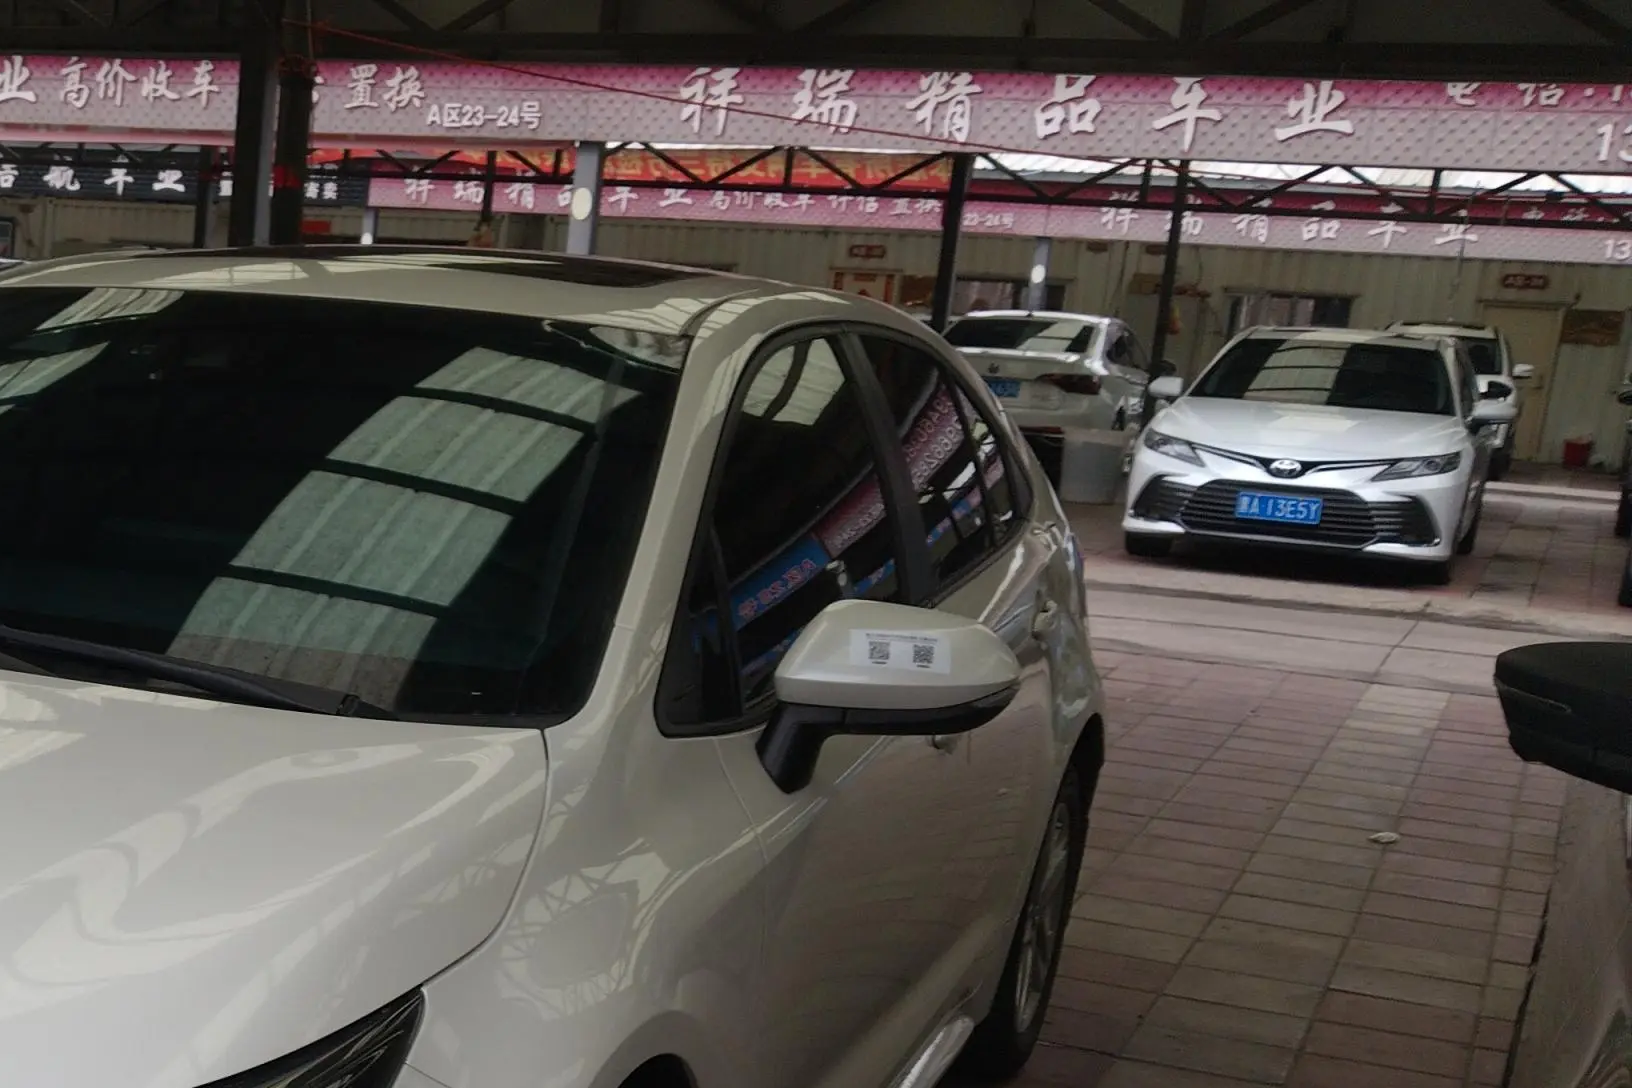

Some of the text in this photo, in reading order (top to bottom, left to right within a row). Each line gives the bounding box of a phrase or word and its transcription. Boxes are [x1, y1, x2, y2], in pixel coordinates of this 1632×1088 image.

[60, 57, 219, 109] 高价收车
[344, 64, 425, 111] 置换
[680, 66, 1354, 151] 祥瑞精品车业
[426, 100, 543, 130] A区23-24号
